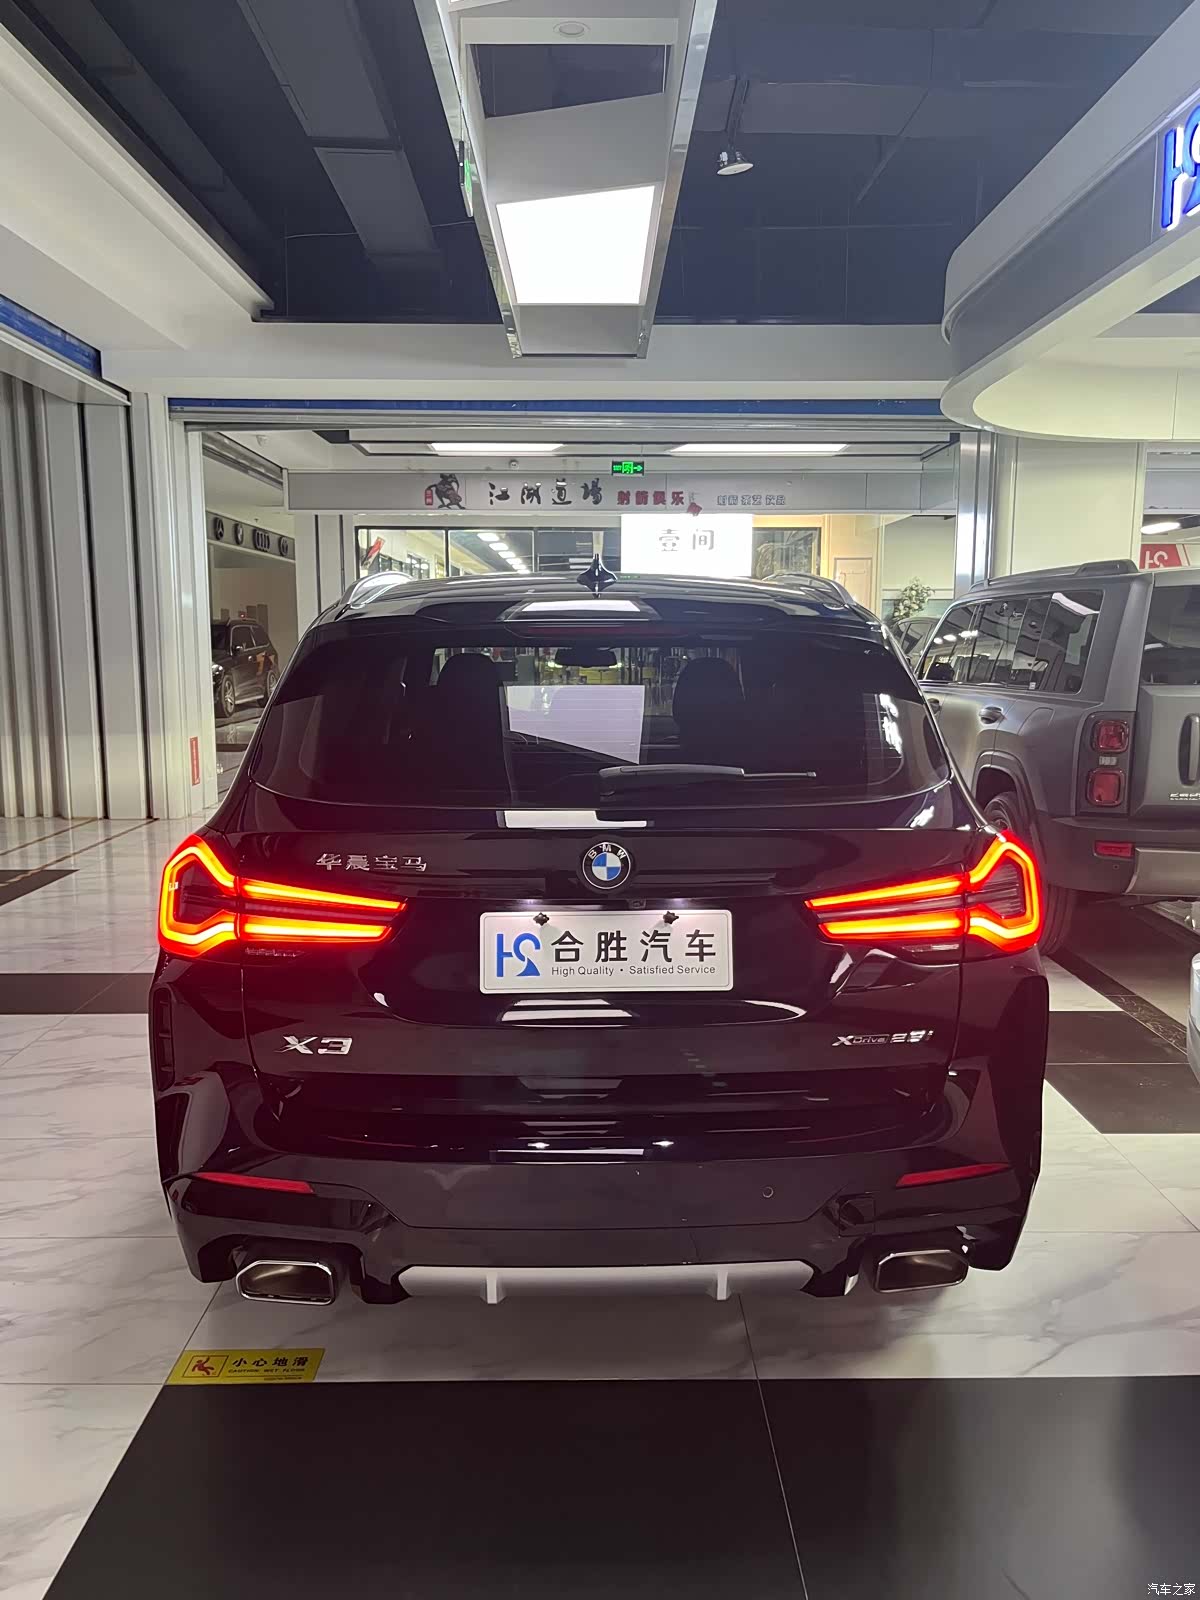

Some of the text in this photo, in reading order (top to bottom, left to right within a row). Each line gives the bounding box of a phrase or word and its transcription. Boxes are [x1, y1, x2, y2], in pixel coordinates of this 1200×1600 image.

[587, 842, 627, 860] BMW
[315, 853, 428, 872] 华晨宝马
[550, 929, 716, 963] 合胜汽车
[551, 964, 716, 977] High Quality Satisfied Service
[274, 1035, 353, 1055] X3
[232, 1356, 308, 1367] 小心地滑
